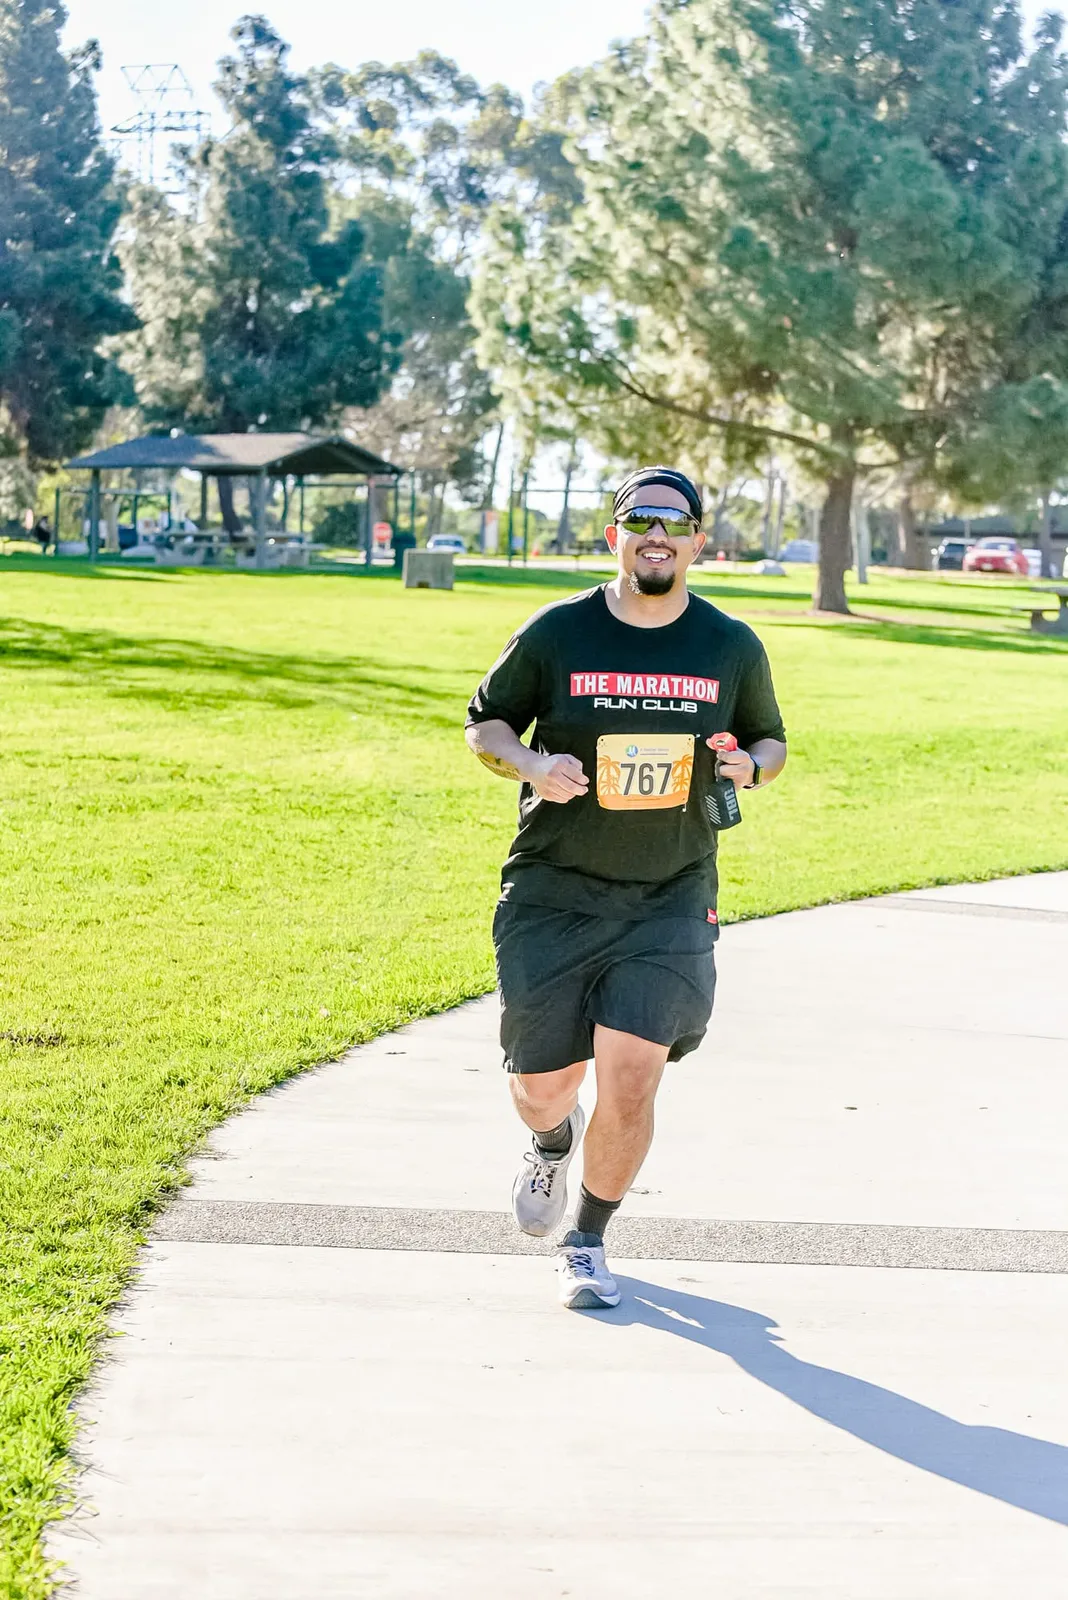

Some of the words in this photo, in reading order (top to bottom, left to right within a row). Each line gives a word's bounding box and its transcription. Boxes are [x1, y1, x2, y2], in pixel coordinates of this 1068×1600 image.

[574, 675, 609, 693] THE
[617, 676, 717, 700] MARATHON
[594, 698, 638, 710] RUN
[642, 699, 698, 713] CLUB
[620, 763, 672, 796] 767
[724, 787, 739, 821] JBL
